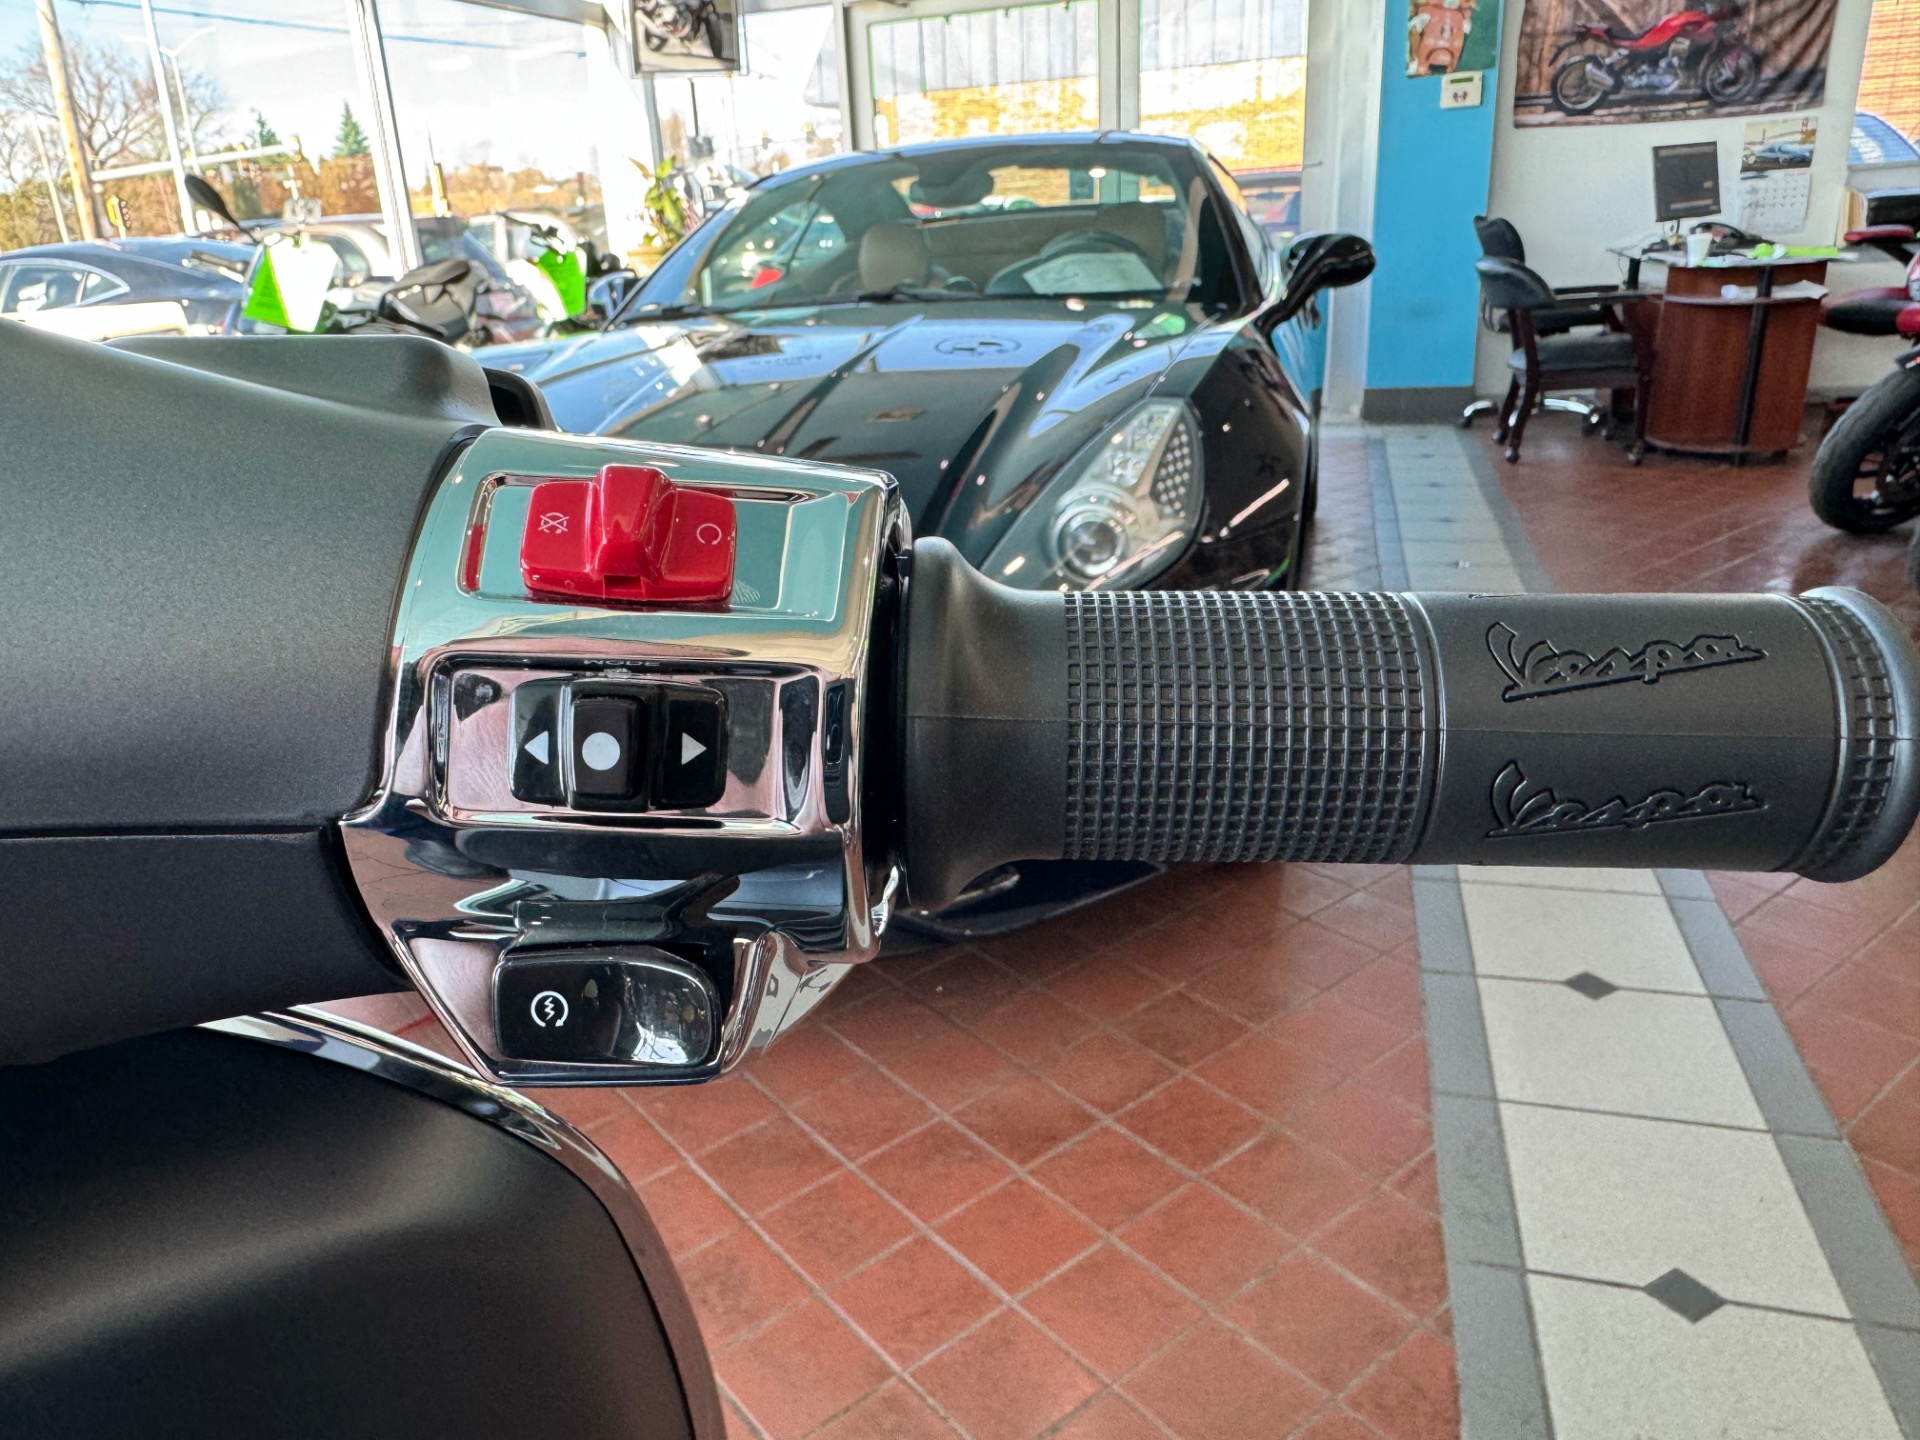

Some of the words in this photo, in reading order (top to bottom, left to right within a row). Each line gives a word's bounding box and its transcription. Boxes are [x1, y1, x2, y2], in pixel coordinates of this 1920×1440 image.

[583, 659, 660, 667] MODE
[1486, 621, 1769, 702] Vespa
[1484, 759, 1769, 839] Vespa
